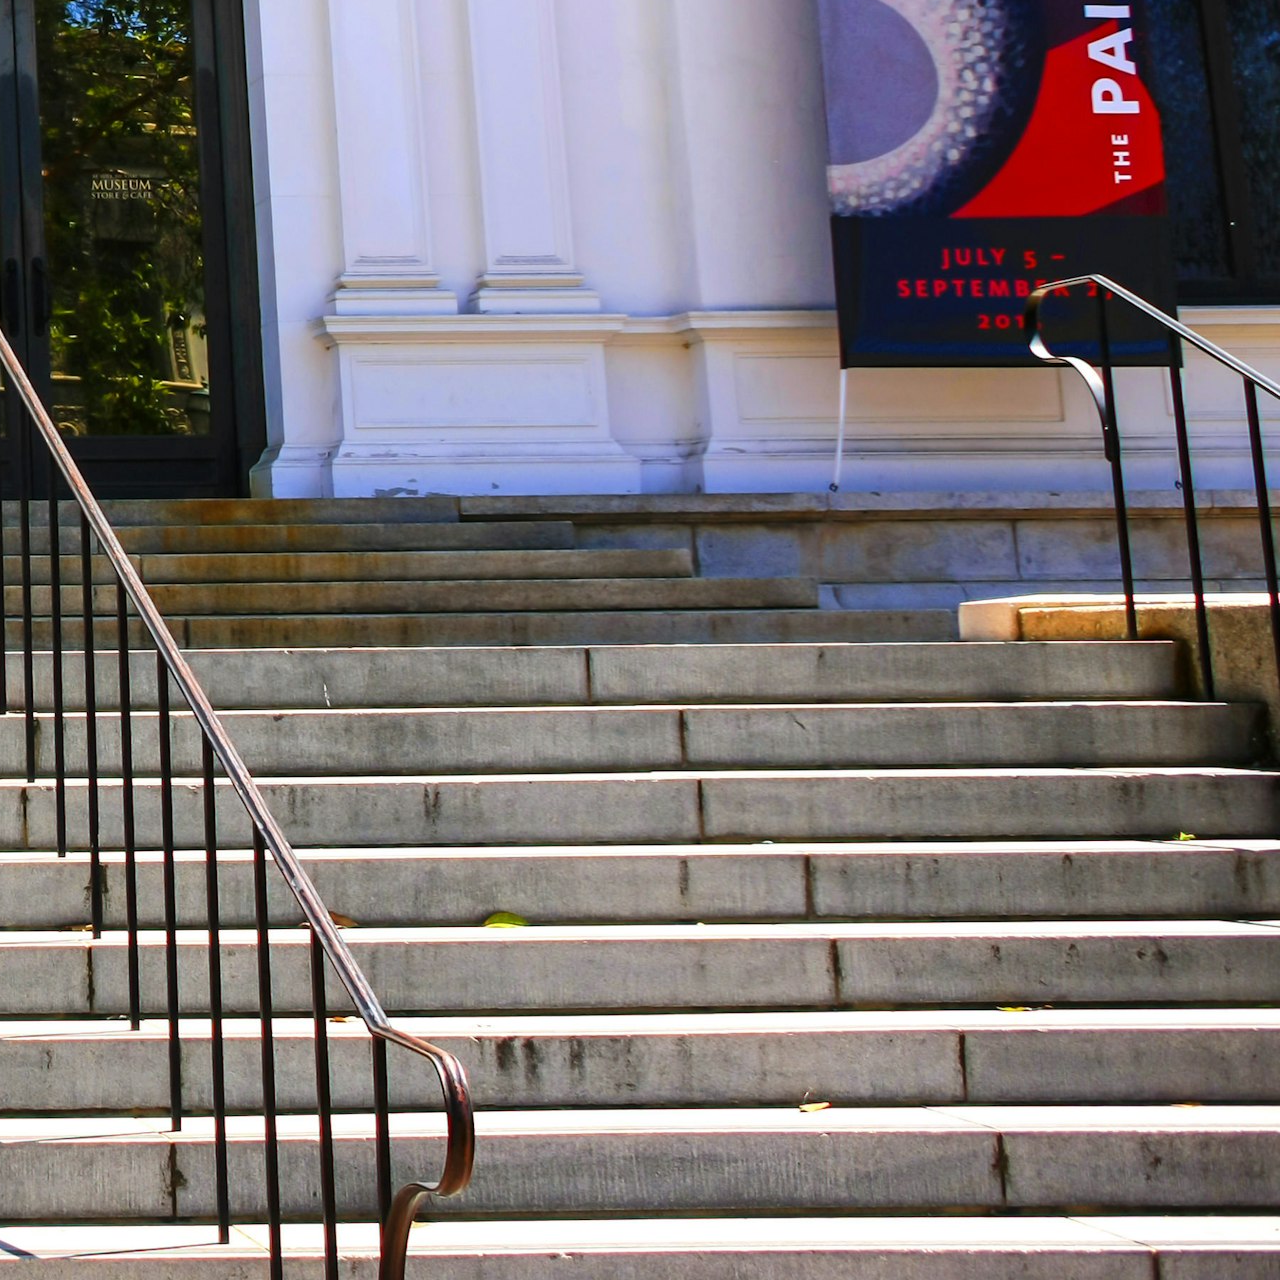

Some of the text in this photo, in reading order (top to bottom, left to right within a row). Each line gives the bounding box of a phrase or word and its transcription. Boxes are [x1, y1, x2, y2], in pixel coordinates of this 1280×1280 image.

[1111, 133, 1132, 184] THE
[91, 179, 151, 190] MUSEUM
[941, 248, 1007, 270] JULY
[1023, 250, 1038, 269] 5
[977, 314, 1043, 330] 201
